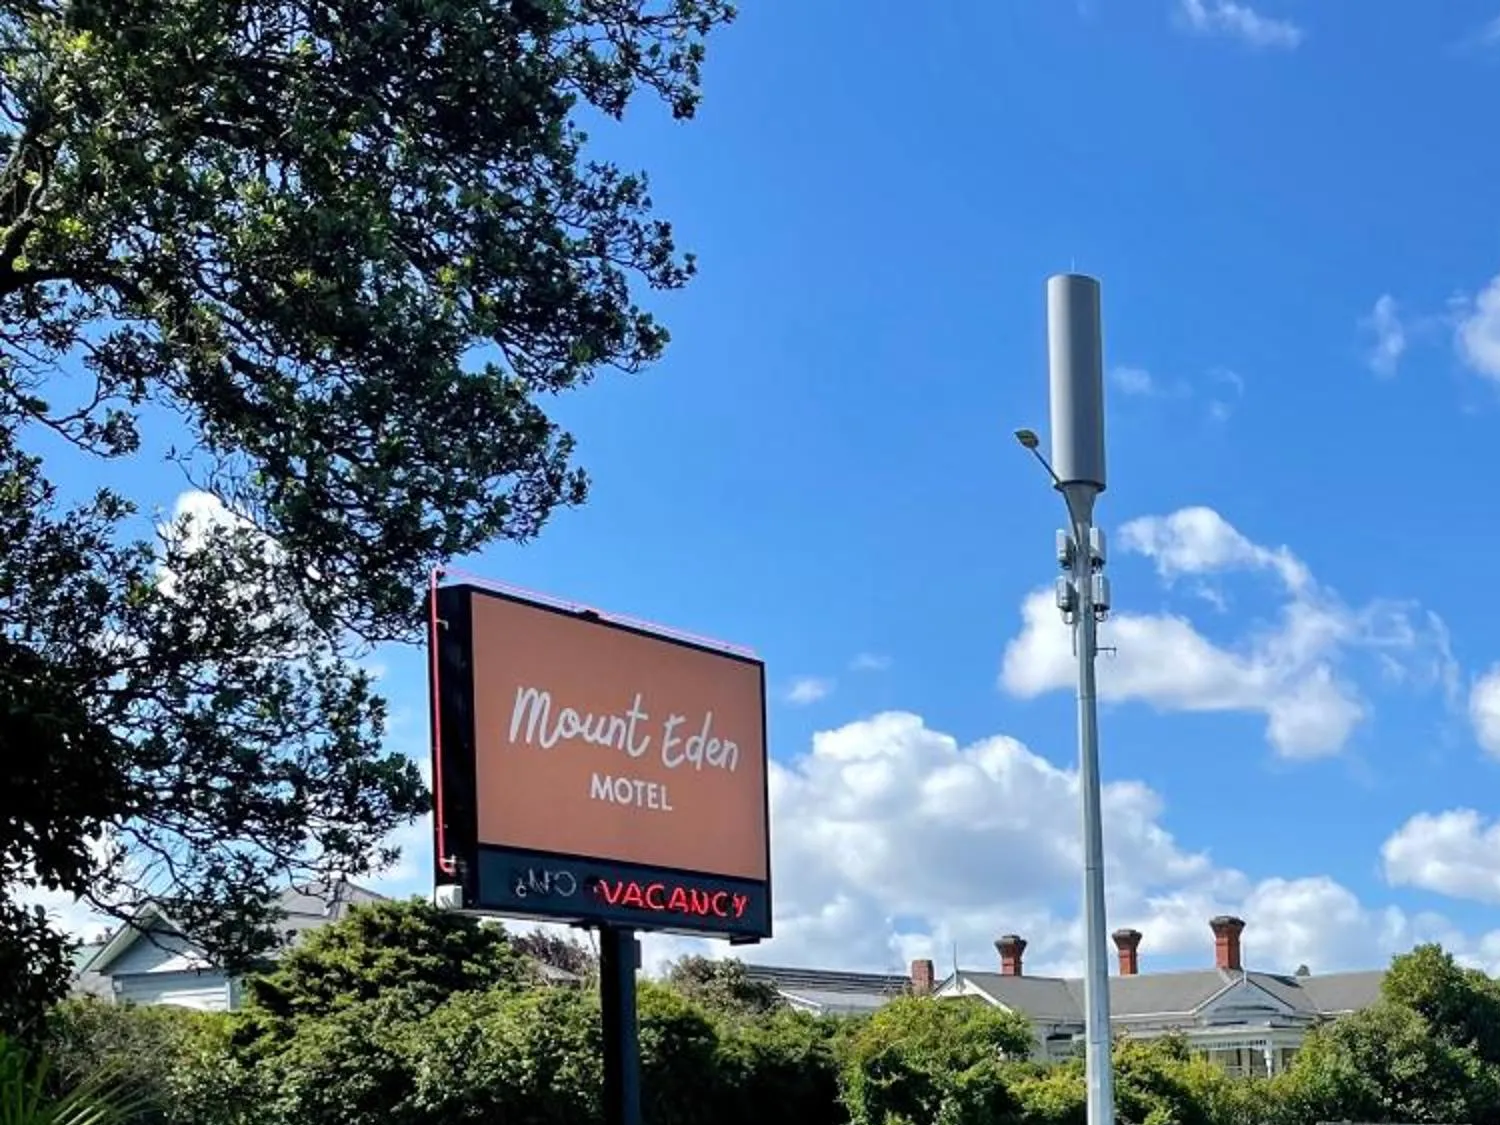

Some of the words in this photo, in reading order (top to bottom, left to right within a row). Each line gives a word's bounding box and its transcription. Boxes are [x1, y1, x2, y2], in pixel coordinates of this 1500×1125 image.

[509, 687, 651, 757] Mount
[661, 711, 738, 772] Eden
[591, 772, 673, 811] MOTEL
[599, 878, 748, 918] VACANCY
